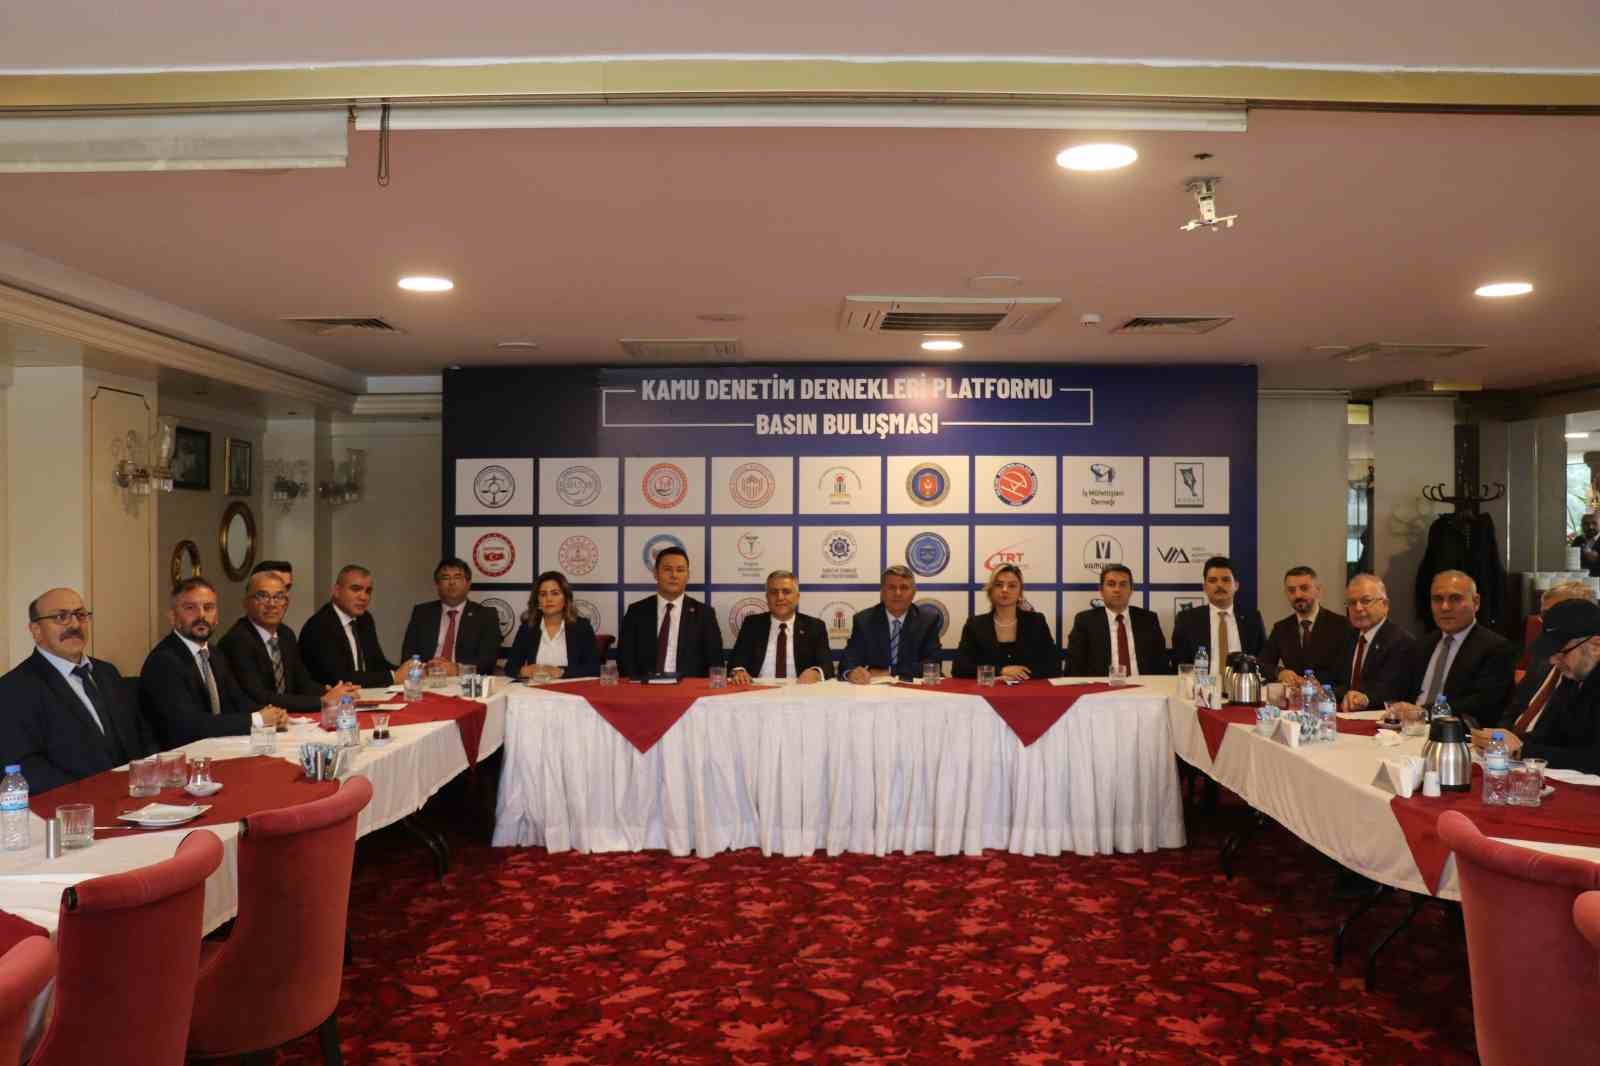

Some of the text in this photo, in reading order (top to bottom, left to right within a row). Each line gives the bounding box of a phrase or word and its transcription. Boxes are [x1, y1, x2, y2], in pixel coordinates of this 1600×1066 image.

[641, 373, 1053, 401] KAMU DENETİM DERNEKLERİ PLATFORMU
[756, 413, 939, 439] BASIN BULUŞMASI
[999, 552, 1024, 563] TRT
